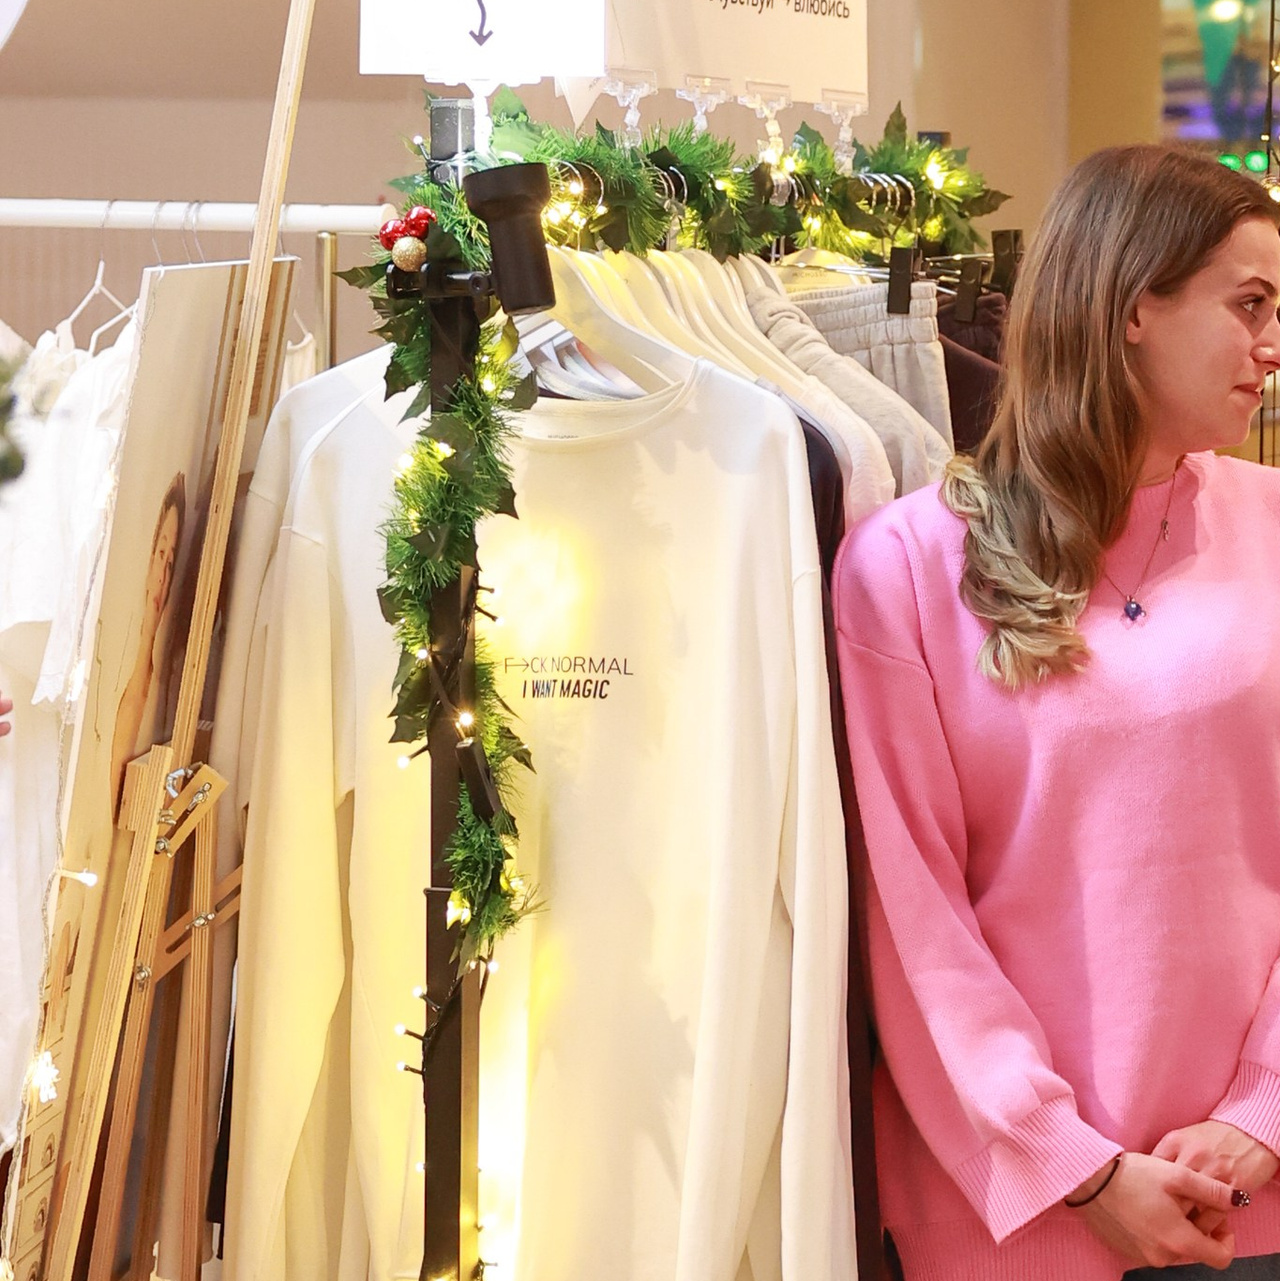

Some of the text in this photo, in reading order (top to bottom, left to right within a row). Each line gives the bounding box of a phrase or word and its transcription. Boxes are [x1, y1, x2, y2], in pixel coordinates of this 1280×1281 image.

[551, 656, 634, 675] NORMAL
[522, 679, 610, 699] I WANT MAGIC
